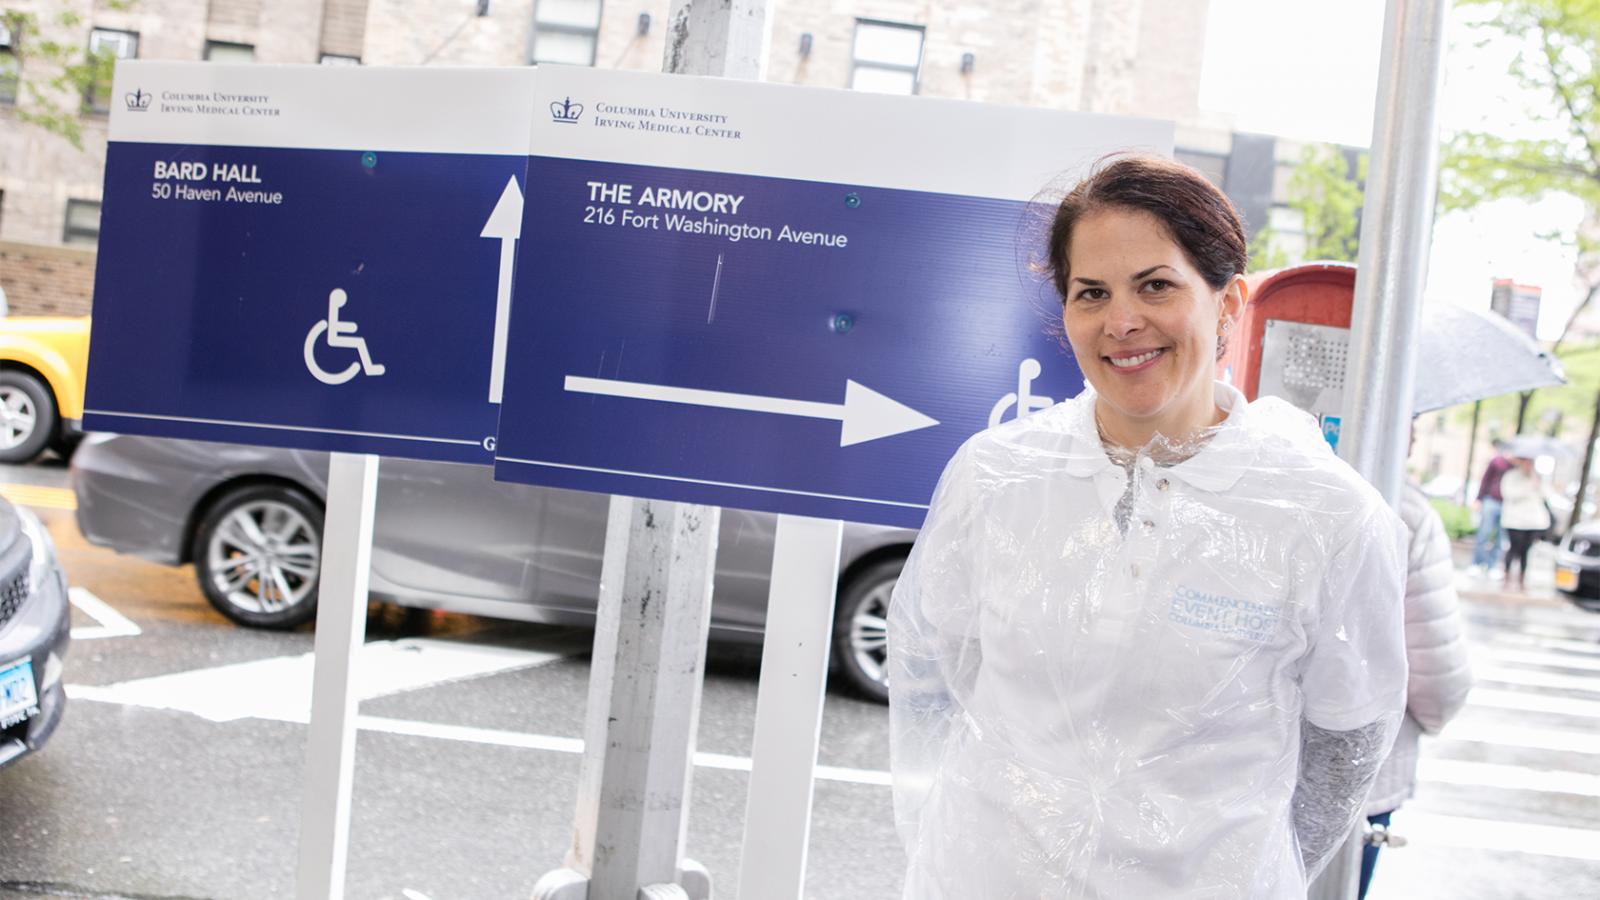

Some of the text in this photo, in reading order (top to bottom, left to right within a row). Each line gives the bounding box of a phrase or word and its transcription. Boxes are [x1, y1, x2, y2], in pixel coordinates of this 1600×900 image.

[161, 91, 270, 104] COLUMBIA UNIVERSITY
[160, 103, 280, 116] IRVING MEDICAL CENTER
[596, 102, 728, 124] COLUMBIA UNIVERSITY
[594, 117, 741, 140] IRVING MEDICAL CENTER
[154, 160, 262, 183] BARD HALL
[152, 183, 283, 204] 50 Haven Avenue
[587, 181, 744, 215] THE ARMORY
[583, 207, 848, 248] 216 Fort Washington Avenue
